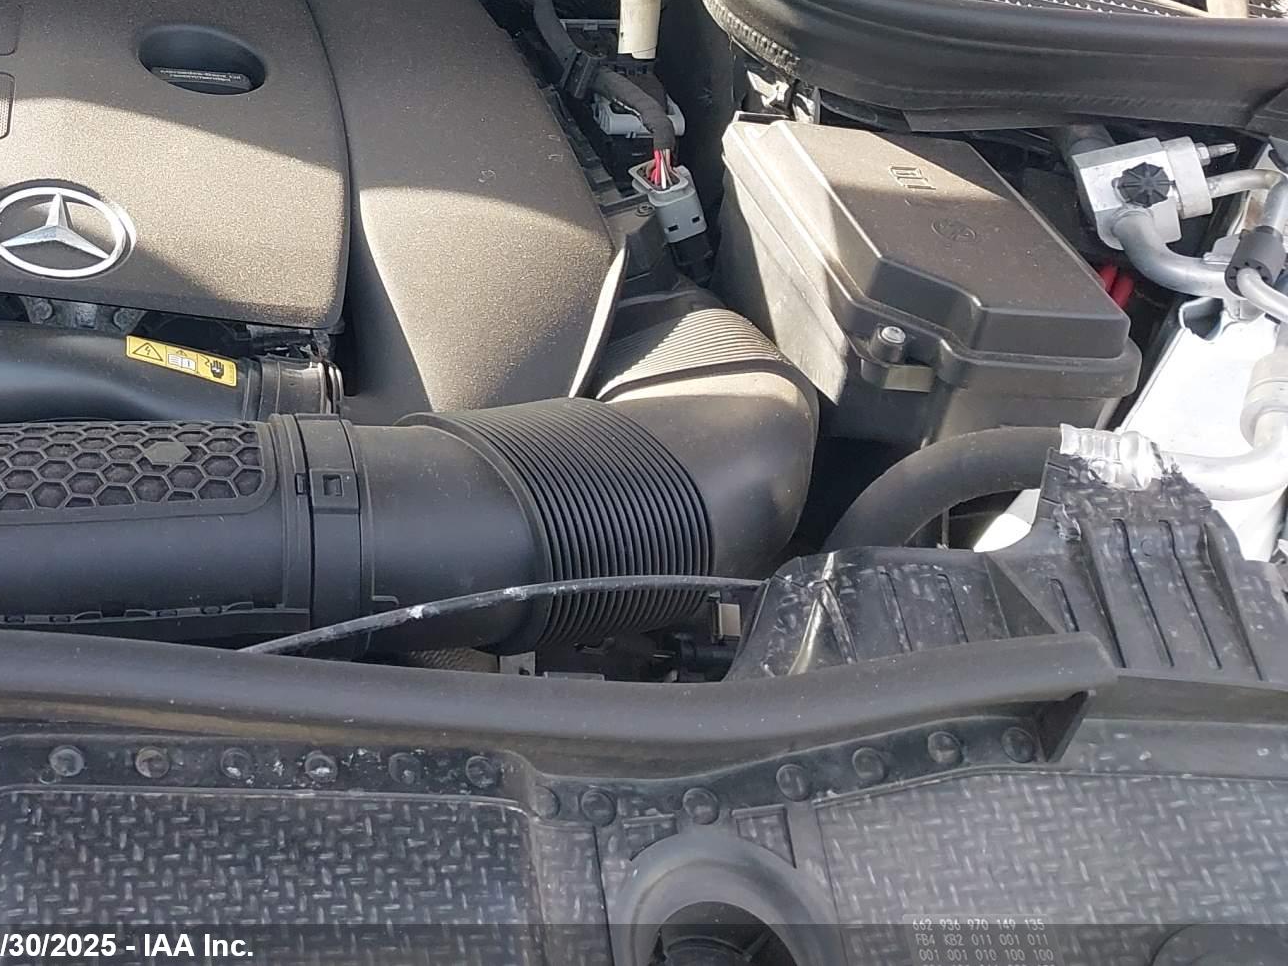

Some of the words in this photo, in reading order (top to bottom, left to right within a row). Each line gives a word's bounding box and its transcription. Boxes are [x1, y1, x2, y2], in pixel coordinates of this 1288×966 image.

[912, 918, 933, 931] 662
[939, 918, 961, 931] 936
[967, 918, 989, 931] 970
[996, 918, 1016, 931] 149
[1024, 918, 1045, 931] 135
[971, 934, 992, 946] 011
[999, 934, 1020, 946] 001
[1027, 934, 1049, 946] 011
[919, 949, 940, 961] 001
[947, 949, 968, 961] 001
[1004, 949, 1025, 961] 100
[1033, 949, 1054, 961] 100
